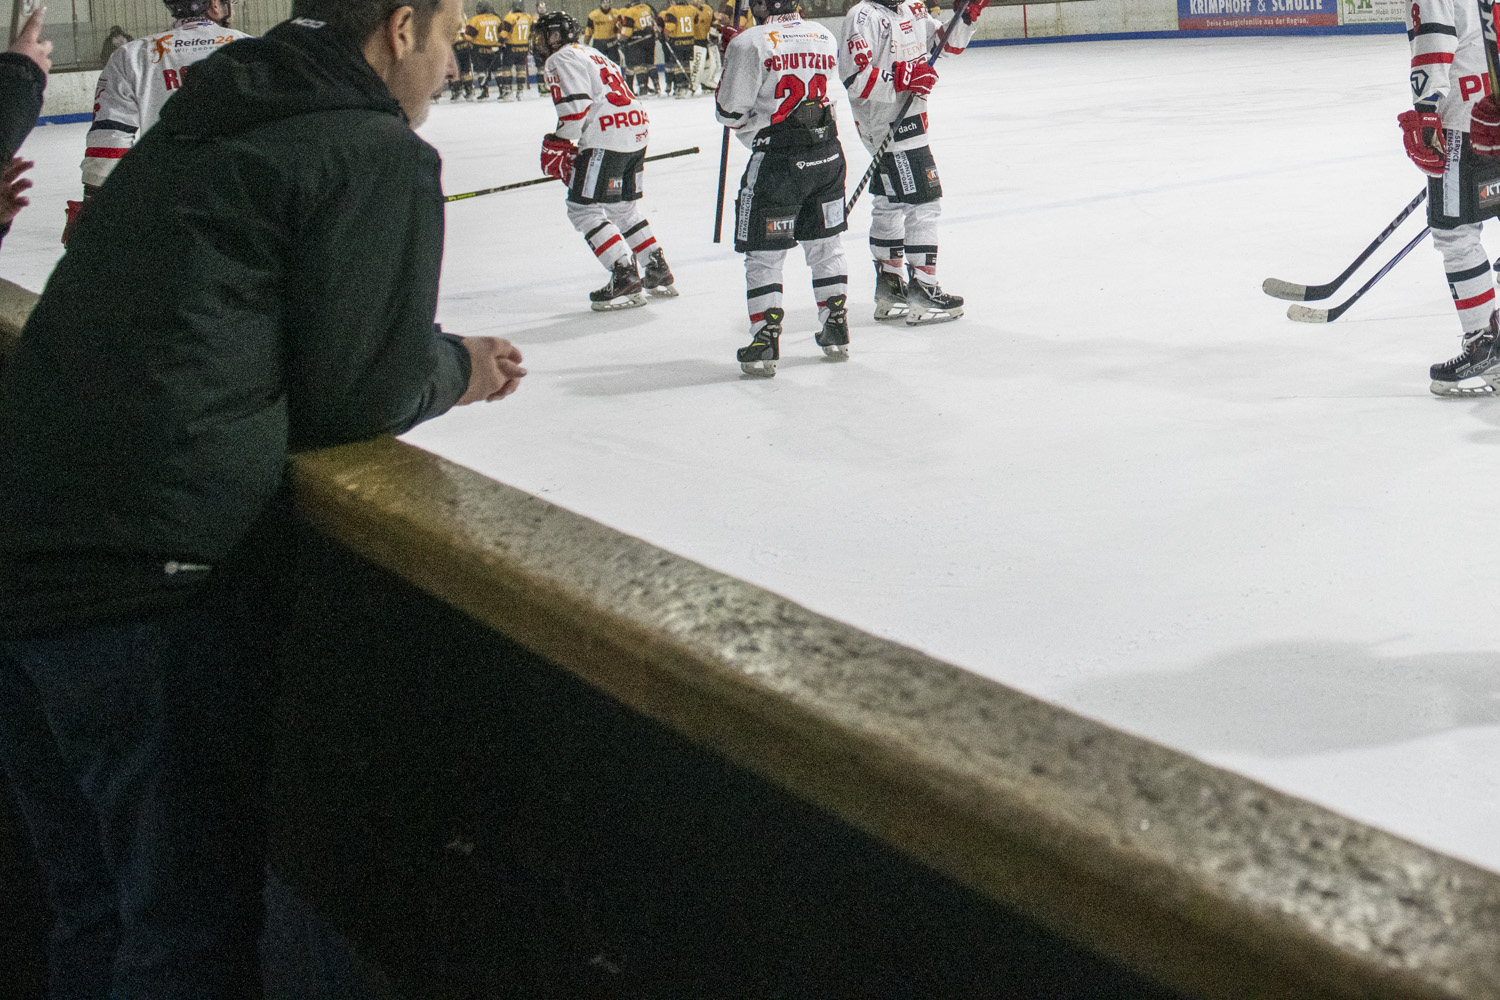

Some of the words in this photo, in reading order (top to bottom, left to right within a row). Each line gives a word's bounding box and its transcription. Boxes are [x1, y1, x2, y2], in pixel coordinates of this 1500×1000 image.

[517, 25, 529, 40] 17
[680, 16, 692, 33] 13
[485, 25, 499, 42] 41
[898, 122, 917, 133] dach
